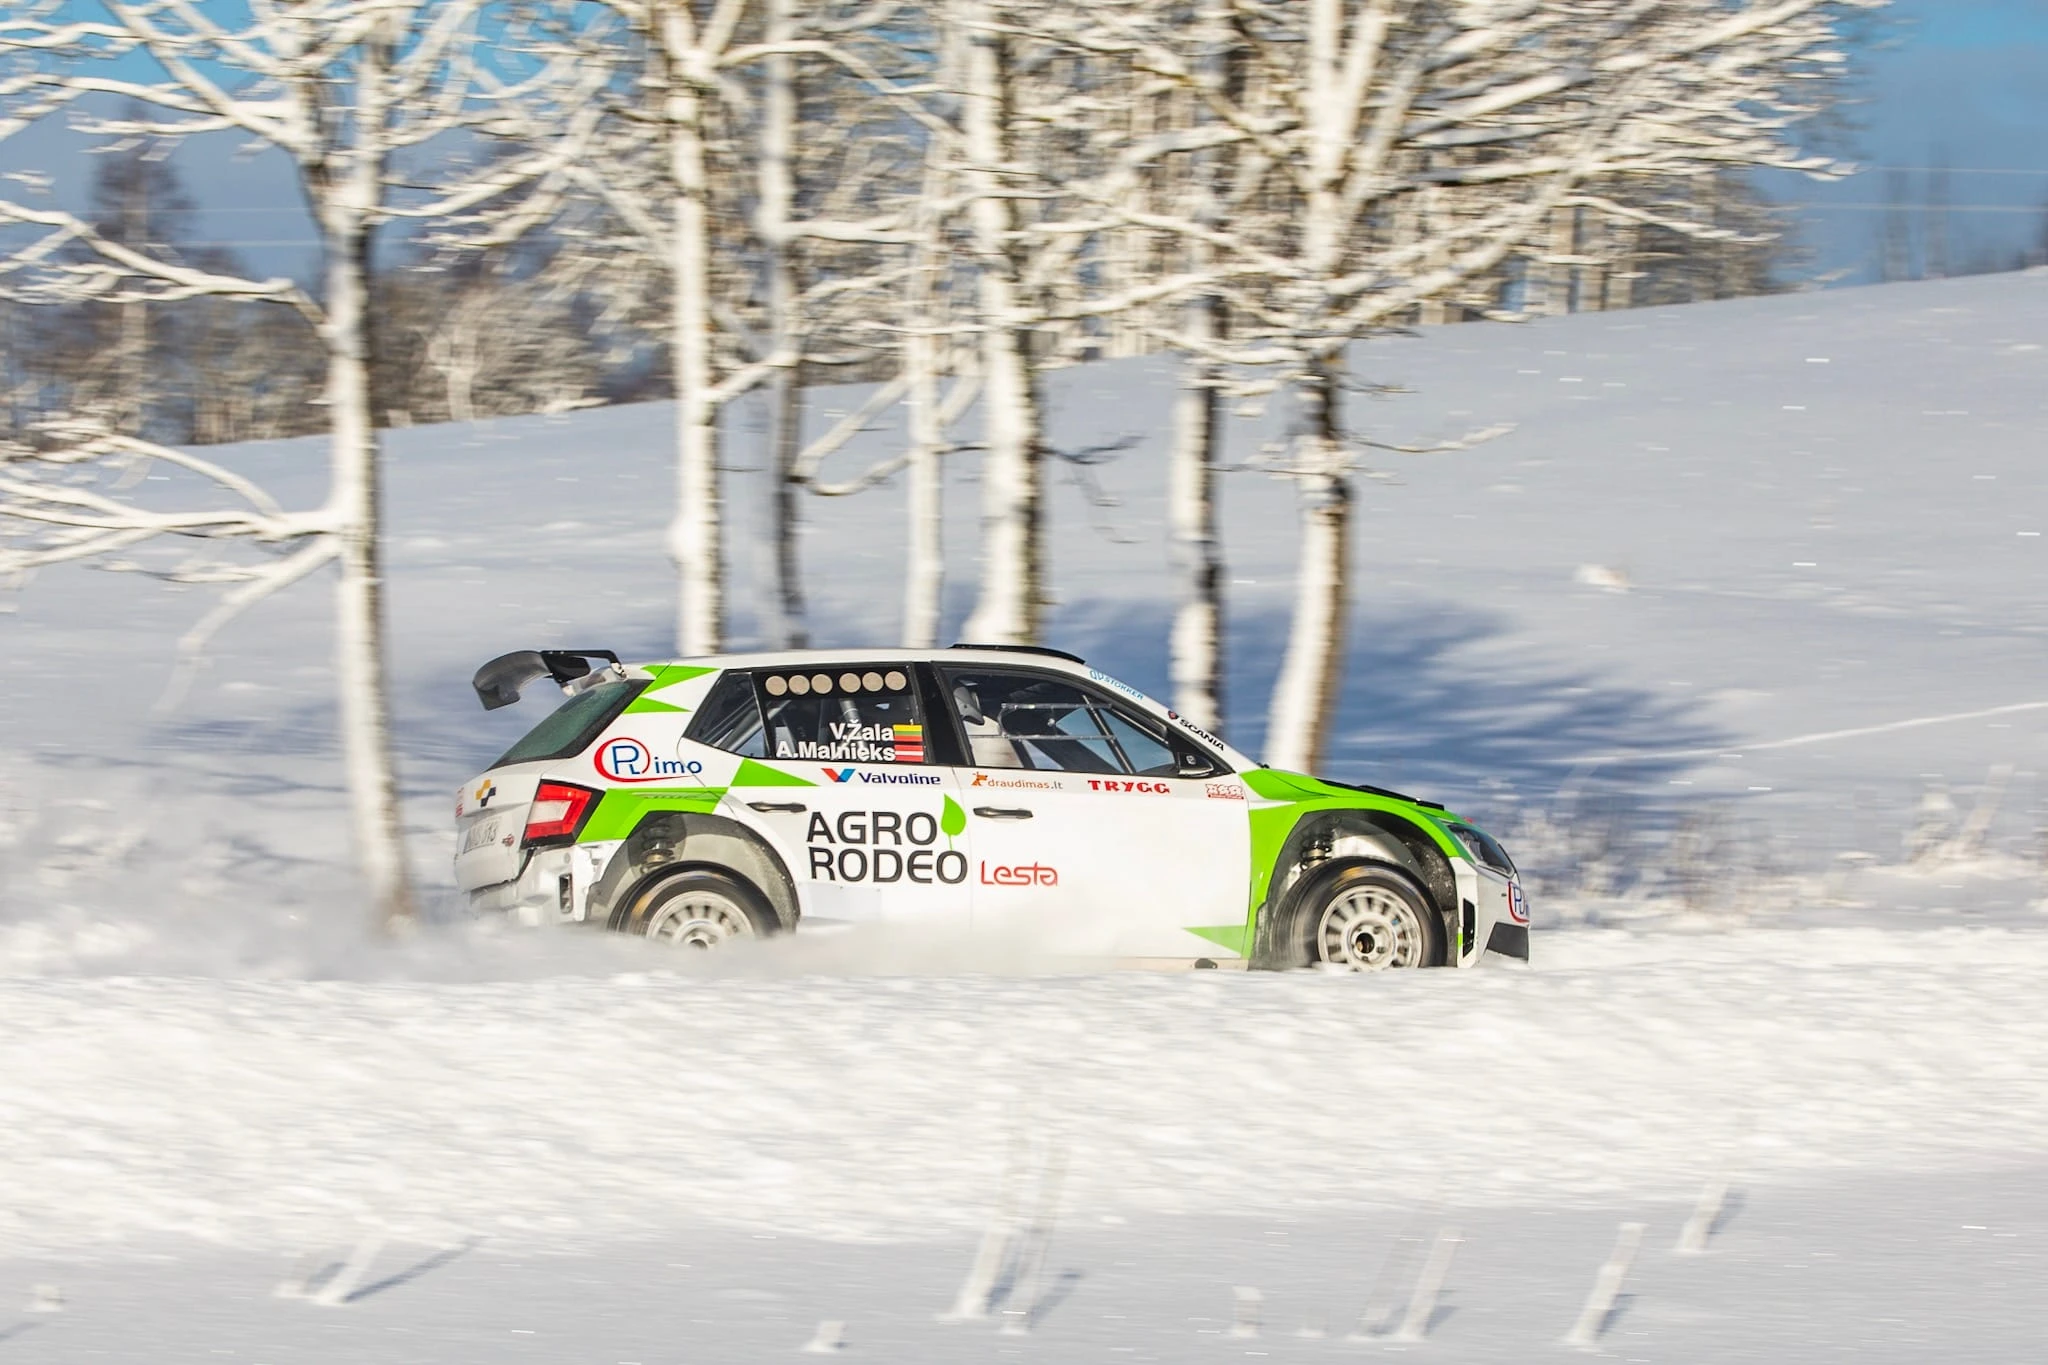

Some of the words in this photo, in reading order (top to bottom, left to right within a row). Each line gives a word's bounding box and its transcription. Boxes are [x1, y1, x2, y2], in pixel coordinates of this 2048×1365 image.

[829, 719, 894, 742] V.Žala
[1180, 718, 1224, 751] SCANIA
[611, 745, 703, 775] Rimo
[858, 771, 941, 785] Valvoline
[987, 777, 1063, 790] draudimas.lt
[1087, 780, 1170, 794] TRYGG
[806, 811, 938, 846] AGRO
[808, 846, 968, 884] RODEO
[980, 860, 1058, 887] Lesta
